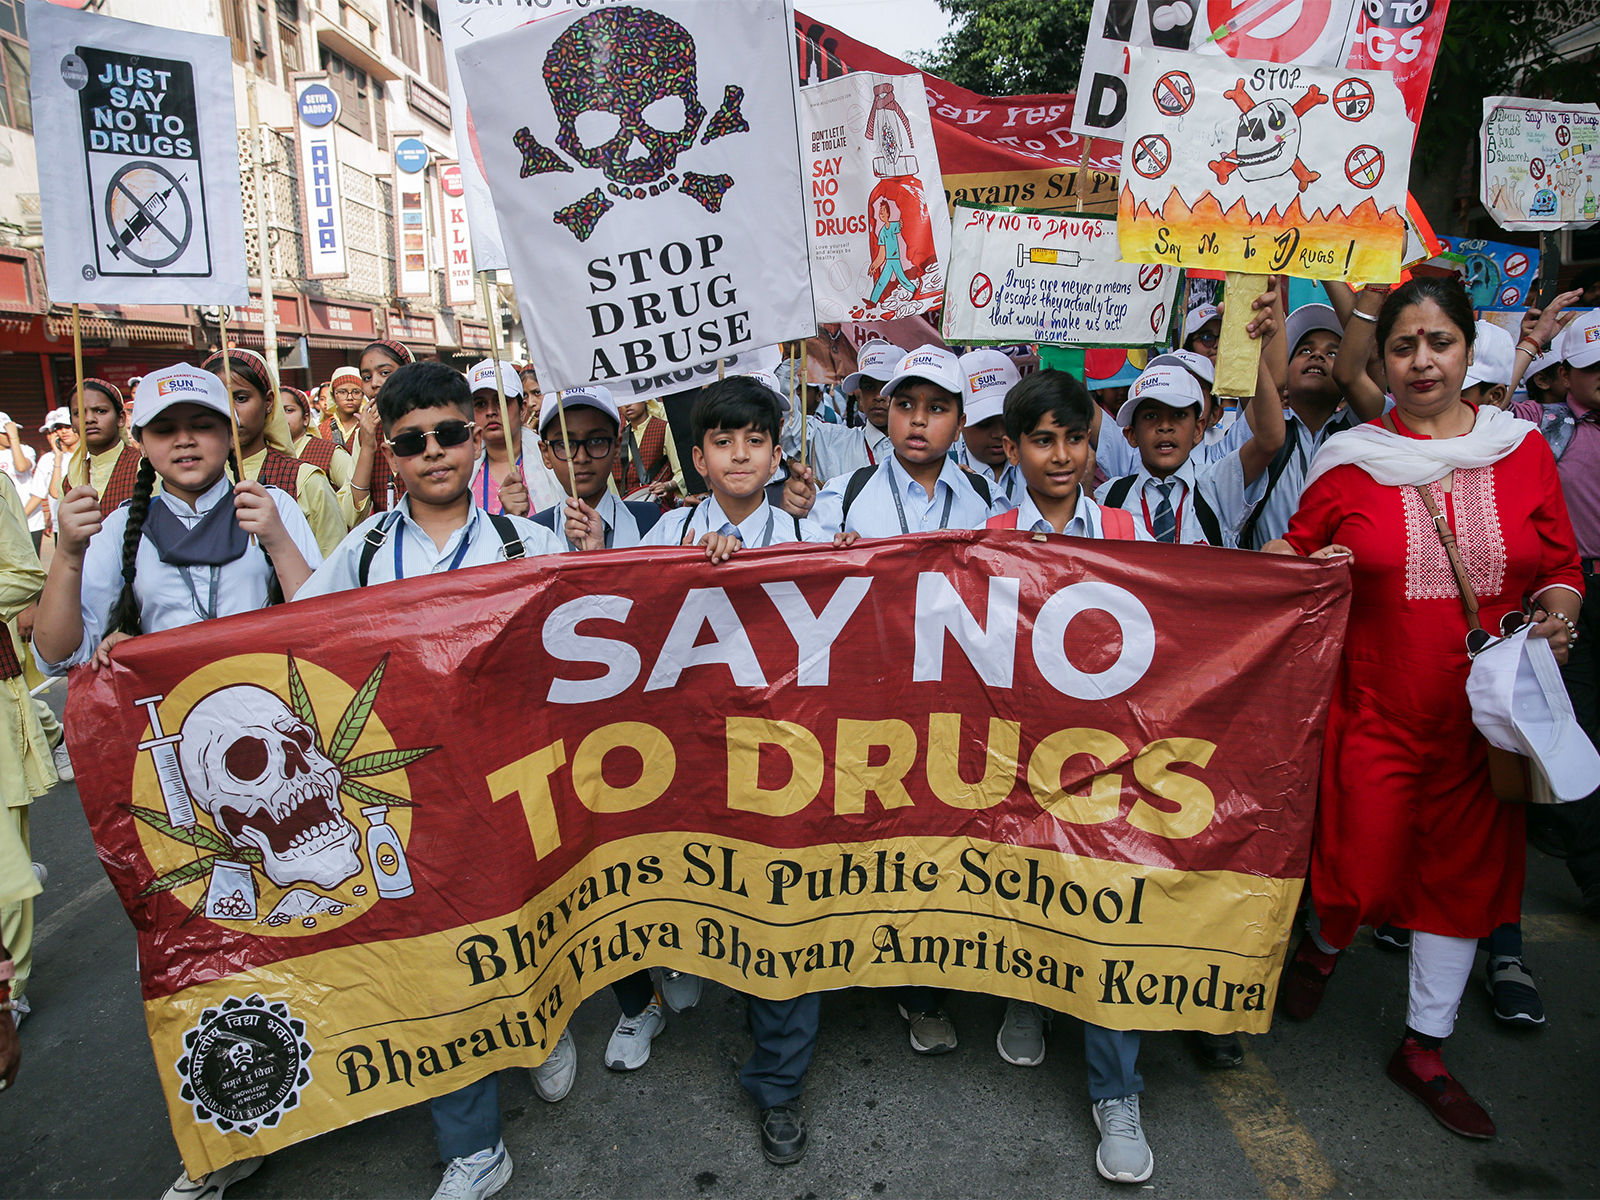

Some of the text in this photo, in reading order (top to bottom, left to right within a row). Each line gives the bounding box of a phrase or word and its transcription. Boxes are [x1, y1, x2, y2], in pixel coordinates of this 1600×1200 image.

[1362, 0, 1428, 23] O TO
[1355, 26, 1424, 63] GS
[98, 63, 171, 90] JUST
[110, 87, 165, 111] SAY
[302, 103, 333, 114] RADIO'S
[305, 94, 327, 104] SETHI
[926, 86, 1066, 128] Say Yes
[95, 108, 184, 135] NO TO
[1487, 122, 1494, 135] E
[1525, 110, 1599, 130] Say No To Drugs
[90, 130, 193, 157] DRUGS
[811, 126, 845, 141] DON'T LET IT
[1488, 136, 1496, 150] A
[811, 137, 847, 153] BE TOO LATE
[1487, 149, 1495, 163] D
[812, 156, 842, 178] SAY
[311, 145, 336, 249] AHUJA
[812, 178, 839, 198] NO
[813, 198, 835, 217] TO
[815, 214, 867, 237] DRUGS
[965, 210, 995, 232] SAY
[1000, 216, 1021, 231] NO
[1027, 216, 1041, 231] TO
[1457, 239, 1488, 253] STOP
[452, 269, 470, 277] STAY
[588, 234, 723, 294] STOP
[456, 279, 469, 287] INN
[1005, 268, 1131, 296] Drugs are never a means
[586, 274, 737, 338] DRUG
[994, 285, 1005, 307] of
[1005, 291, 1037, 309] escape
[1104, 297, 1127, 319] trap
[988, 308, 1015, 327] that
[1016, 310, 1045, 327] would
[1085, 314, 1100, 331] us
[588, 311, 752, 382] ABUSE
[912, 357, 932, 365] SUN
[912, 362, 943, 370] FOUNDATION
[169, 380, 194, 388] SUN
[480, 370, 494, 378] SUN
[978, 374, 996, 385] SUN
[1141, 378, 1158, 386] SUN
[171, 386, 208, 395] FOUNDATION
[565, 387, 585, 395] SUN
[980, 380, 1007, 389] FOUNDATION
[1141, 383, 1170, 391] FOUNDATION
[541, 571, 1156, 704] SAY NO
[485, 712, 1218, 862] TO DRUGS
[456, 841, 1145, 987] Bhavans SL Public School
[335, 915, 1267, 1097] Bharatiya Vidya Bhavan Amritsar Kendra
[225, 1014, 260, 1029] विद्या
[267, 1018, 294, 1046] भवन
[232, 1082, 269, 1100] KNOWLEDGE
[244, 1090, 267, 1103] NECTAR
